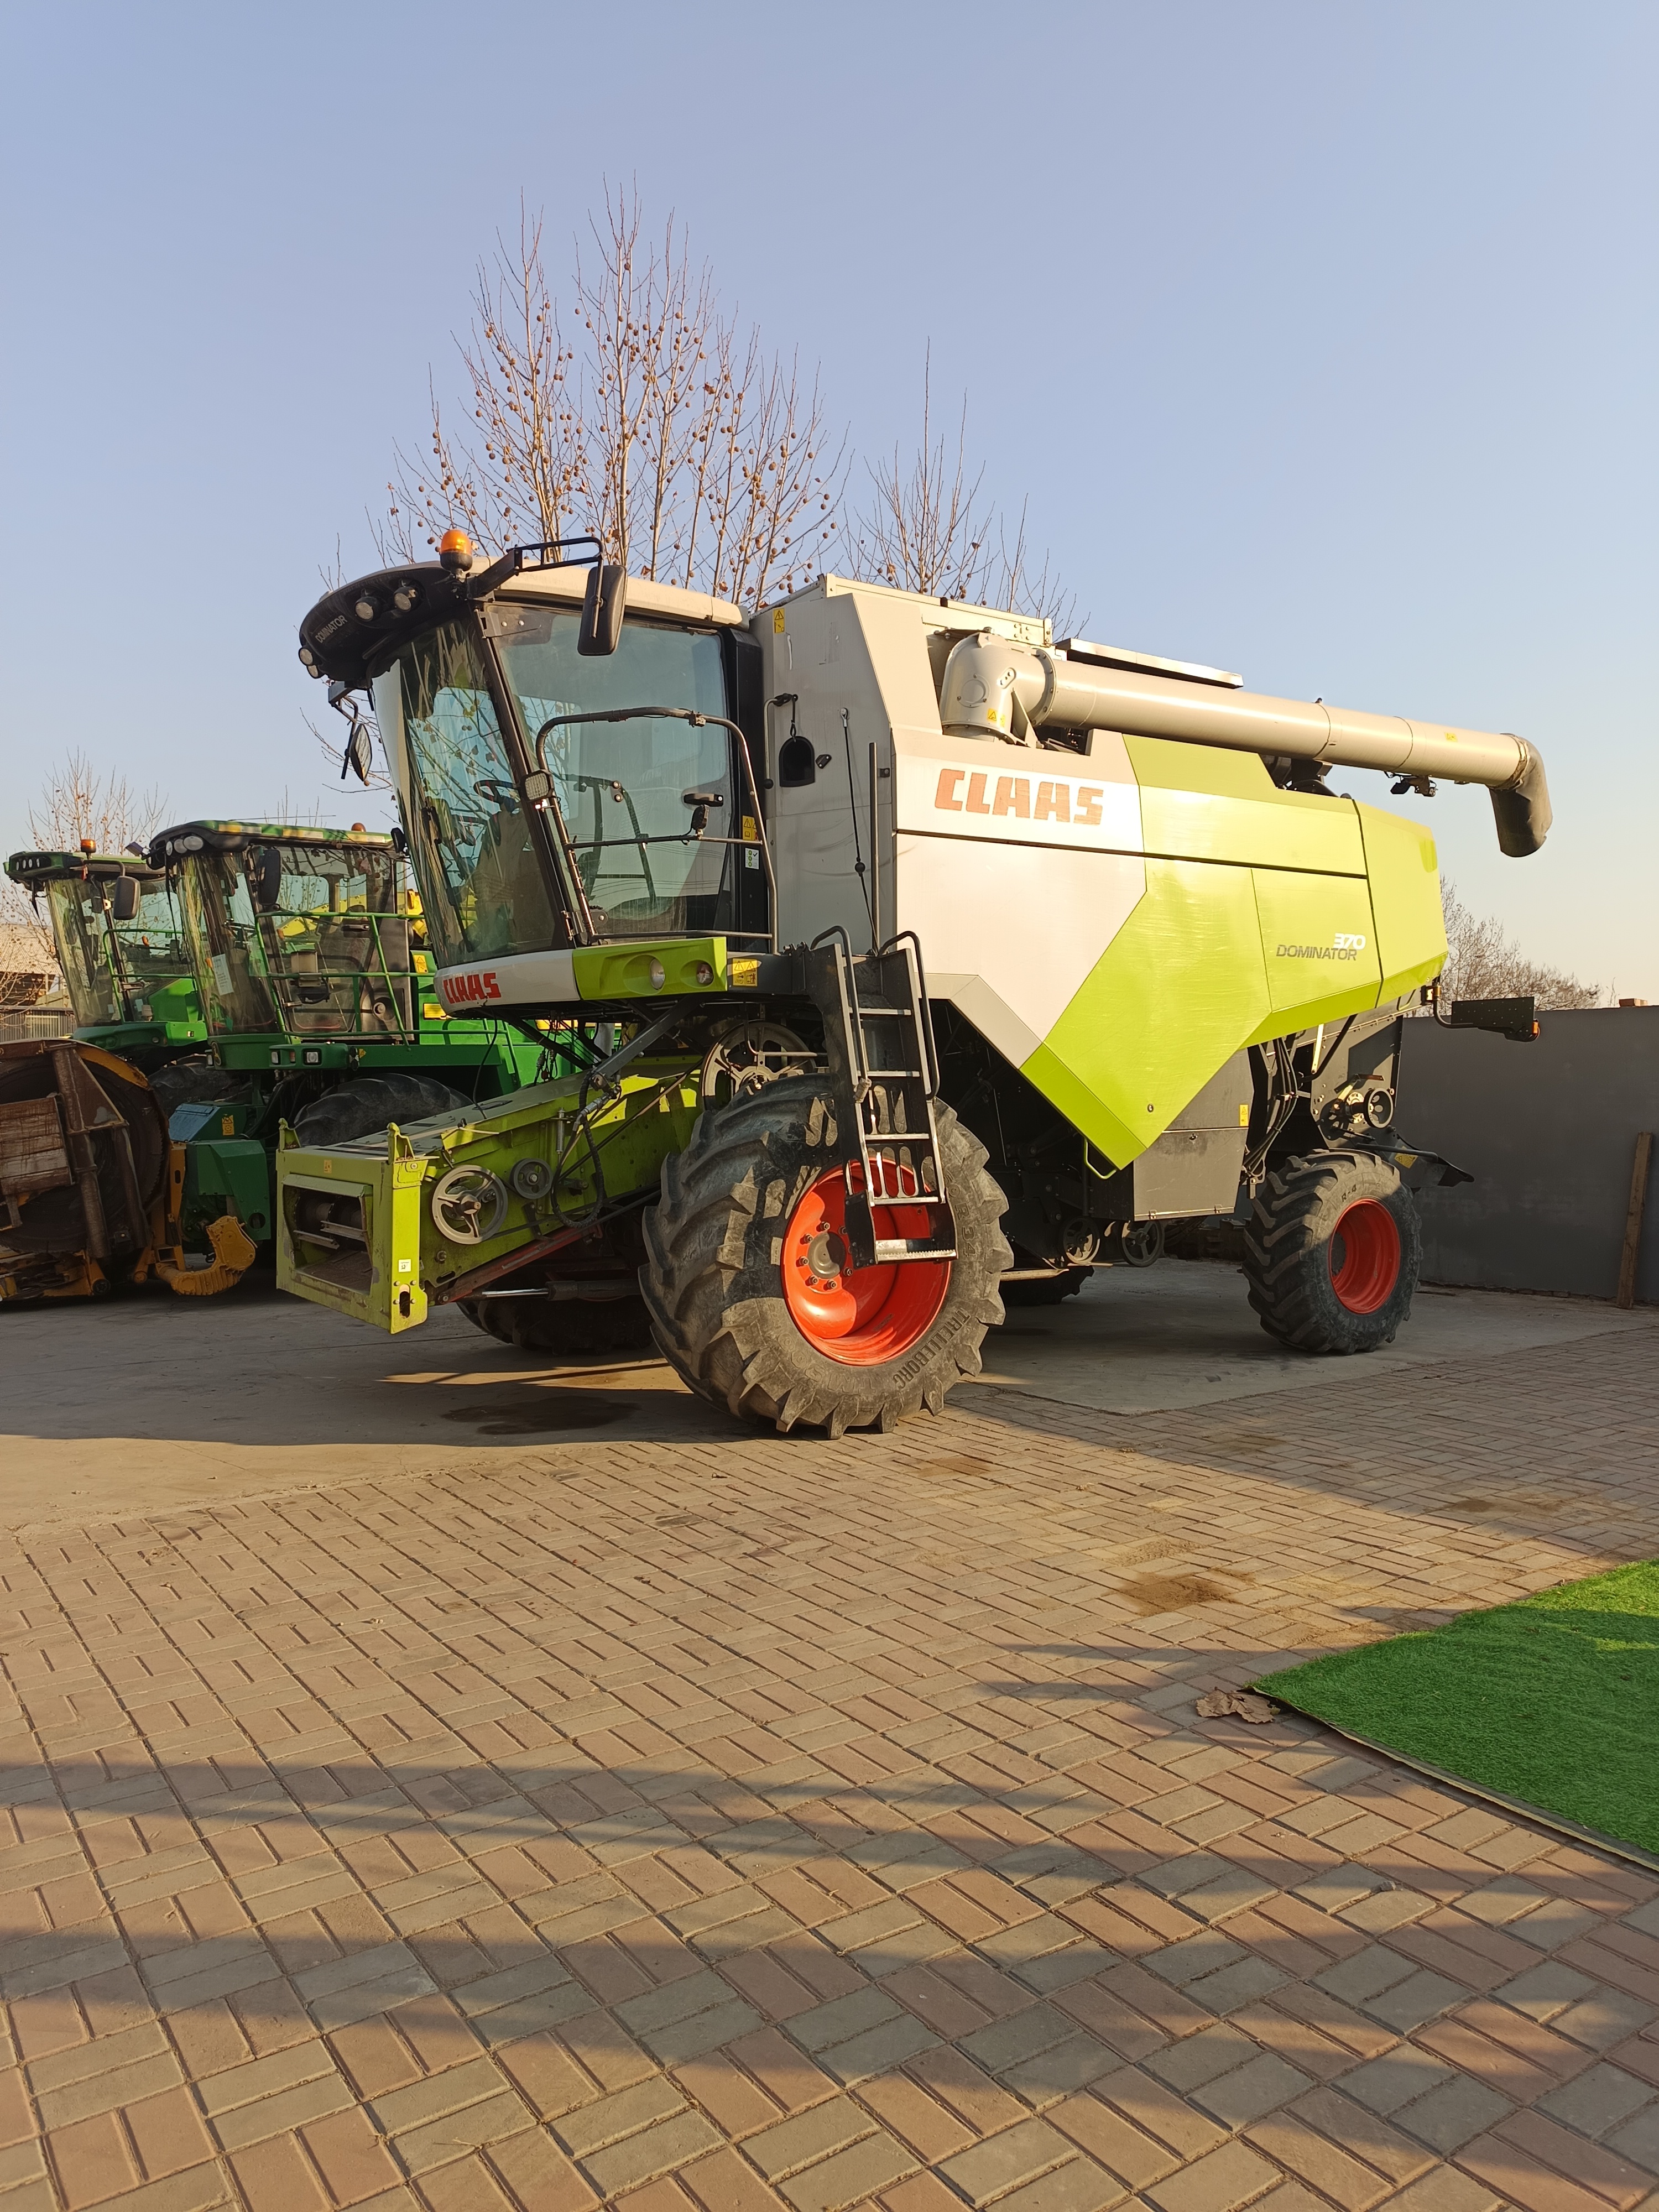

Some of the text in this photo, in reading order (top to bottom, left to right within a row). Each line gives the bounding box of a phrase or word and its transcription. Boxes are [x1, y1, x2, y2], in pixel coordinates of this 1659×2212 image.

[315, 615, 348, 643] DOMINATOR
[935, 769, 1104, 826] CLAAS
[1276, 944, 1357, 961] DOMINATOR
[1333, 932, 1366, 950] 370
[444, 973, 502, 1004] CLAAS
[893, 1309, 971, 1389] TRELLEBORG
